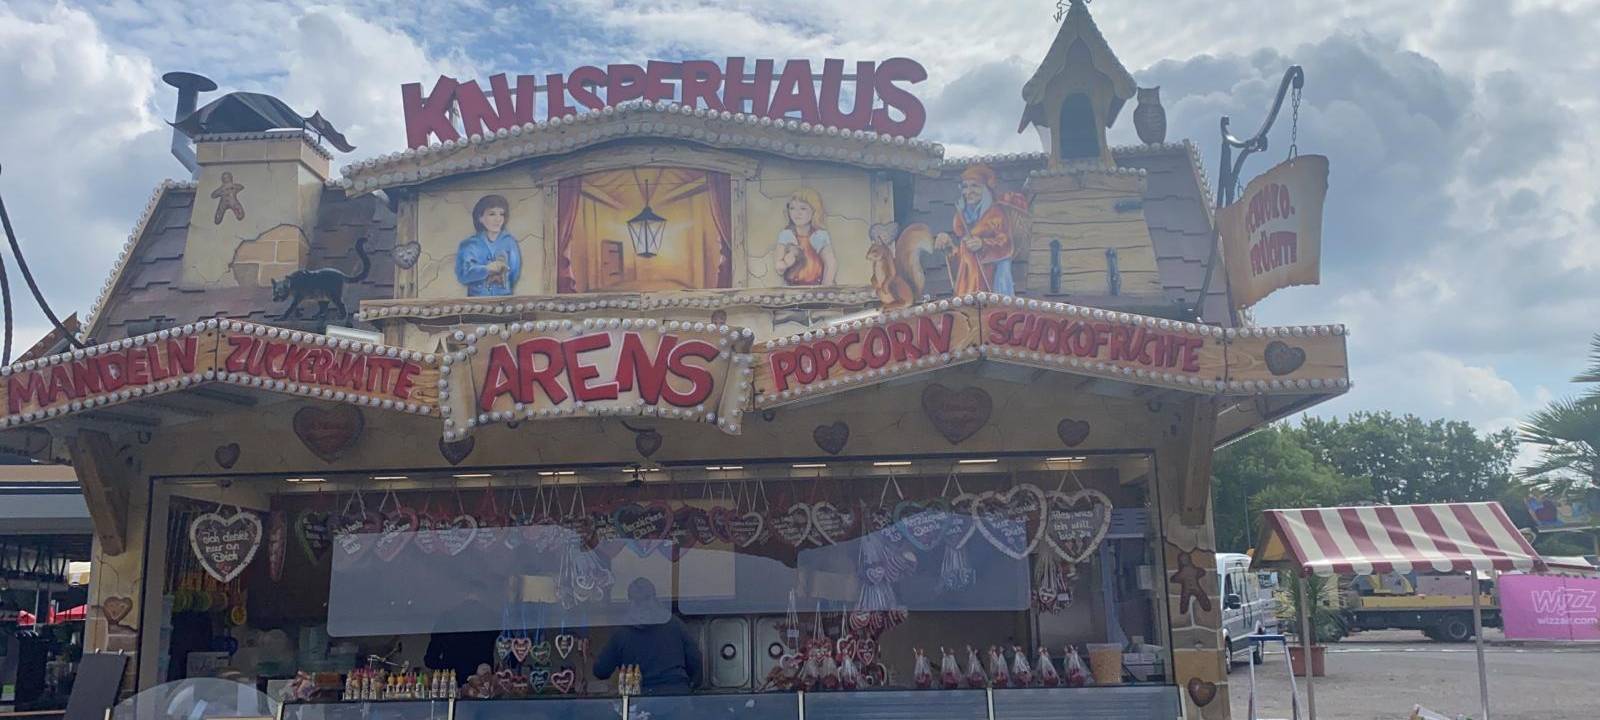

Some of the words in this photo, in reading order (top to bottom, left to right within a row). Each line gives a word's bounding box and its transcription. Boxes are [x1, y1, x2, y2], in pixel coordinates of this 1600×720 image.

[401, 56, 928, 149] KNUSPERHAUS
[7, 335, 199, 414] MANDELN
[226, 335, 421, 401] ZUCKERWATTE
[479, 332, 718, 411] ARENS
[768, 312, 955, 392] POPCORN
